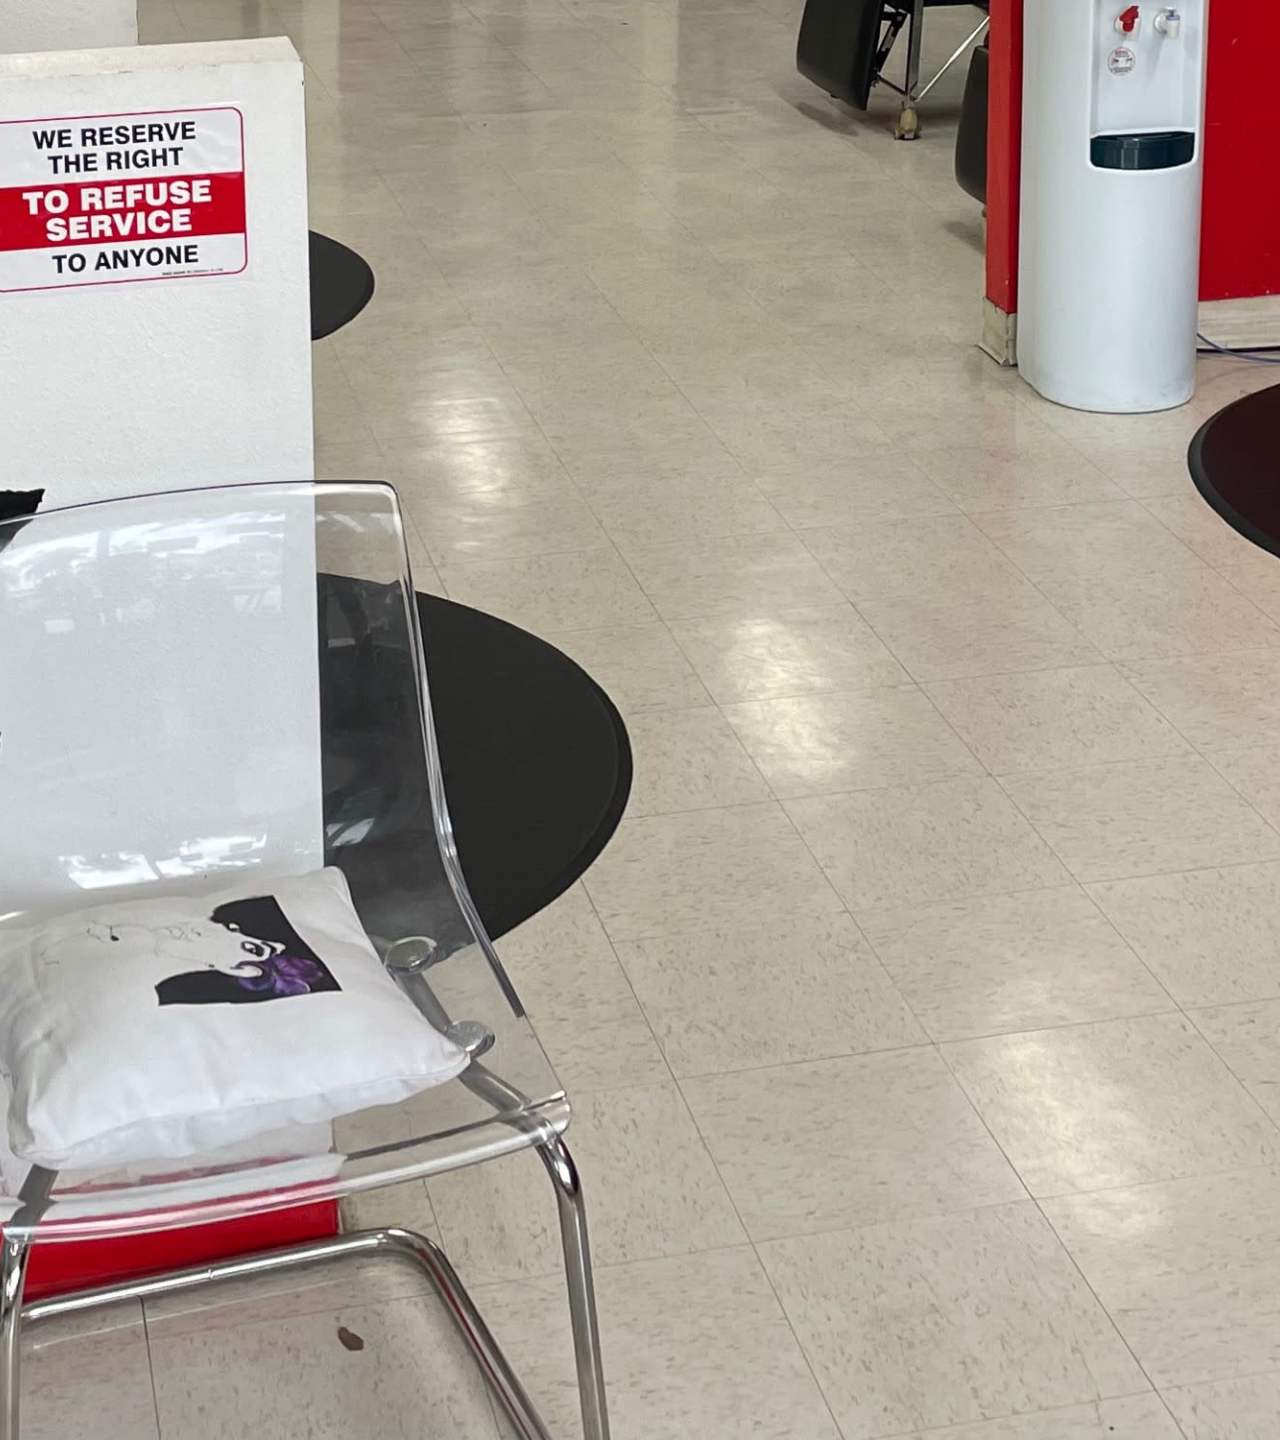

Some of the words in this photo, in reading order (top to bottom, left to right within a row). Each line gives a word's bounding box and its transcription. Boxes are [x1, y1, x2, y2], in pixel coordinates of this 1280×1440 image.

[32, 129, 73, 150] WE
[80, 121, 196, 147] RESERVE
[48, 153, 98, 174] THE
[106, 147, 184, 171] RIGHT
[22, 190, 70, 215] TO
[80, 180, 212, 210] REFUSE
[46, 208, 193, 242] SERVICE
[52, 254, 86, 274] TO
[95, 245, 199, 271] ANYONE
